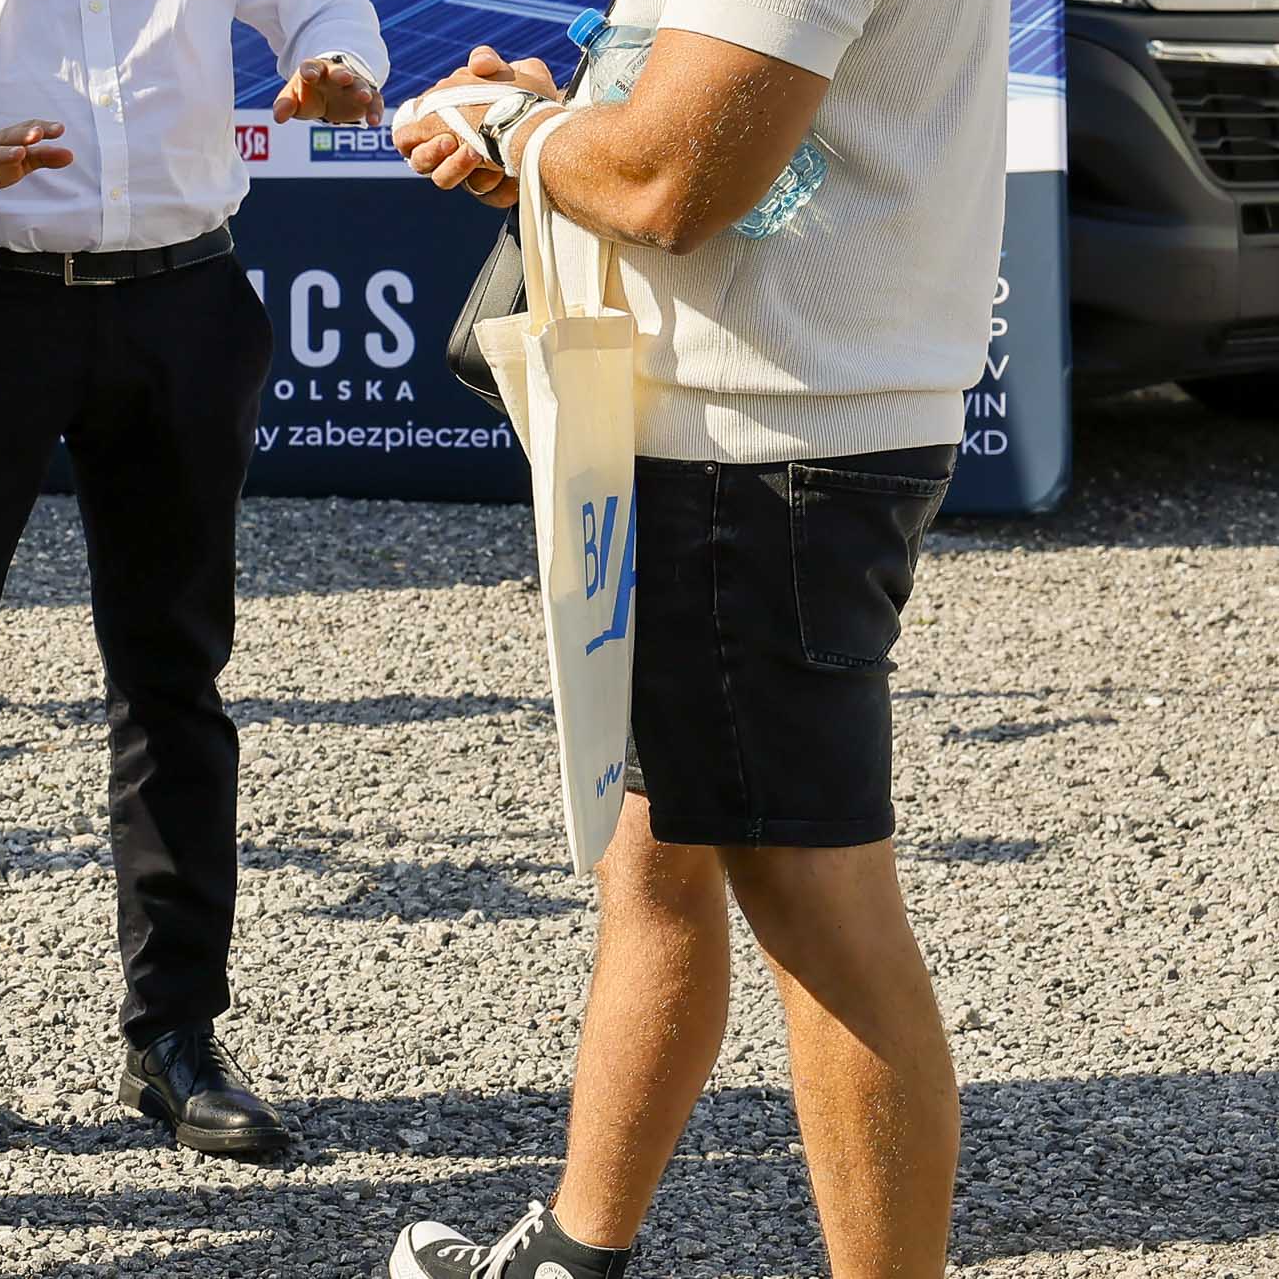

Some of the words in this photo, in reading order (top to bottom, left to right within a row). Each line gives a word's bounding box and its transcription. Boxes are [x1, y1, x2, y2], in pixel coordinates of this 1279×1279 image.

[247, 270, 415, 368] CS
[274, 380, 414, 401] OLSKA
[288, 420, 512, 453] zabezpieczeń
